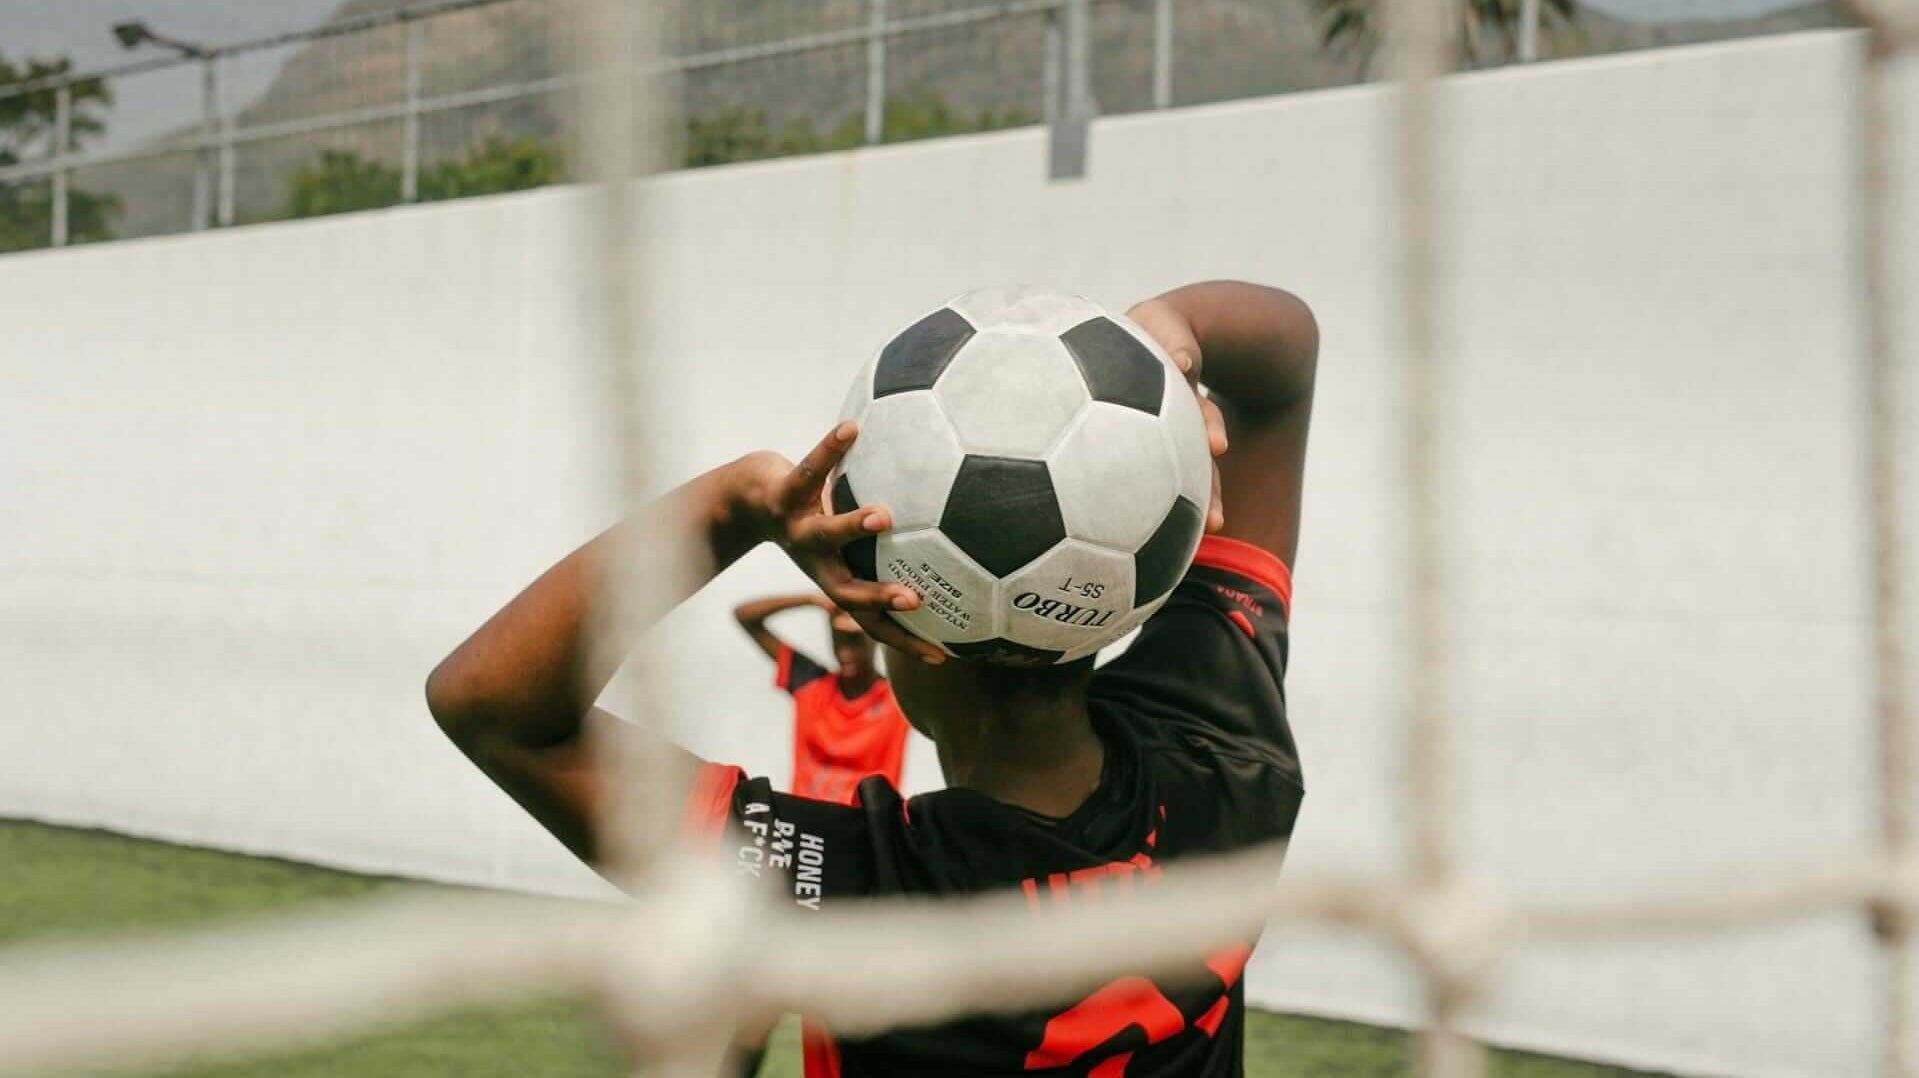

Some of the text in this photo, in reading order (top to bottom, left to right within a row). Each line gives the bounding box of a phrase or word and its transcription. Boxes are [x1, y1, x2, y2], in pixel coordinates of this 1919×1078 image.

[895, 559, 970, 620] WATER PROOF
[920, 563, 962, 598] SIZE 5
[1057, 577, 1105, 599] S5-T
[927, 602, 968, 629] NYLON
[1013, 592, 1117, 627] TURBO
[743, 801, 770, 815] A
[795, 832, 825, 911] HONEY
